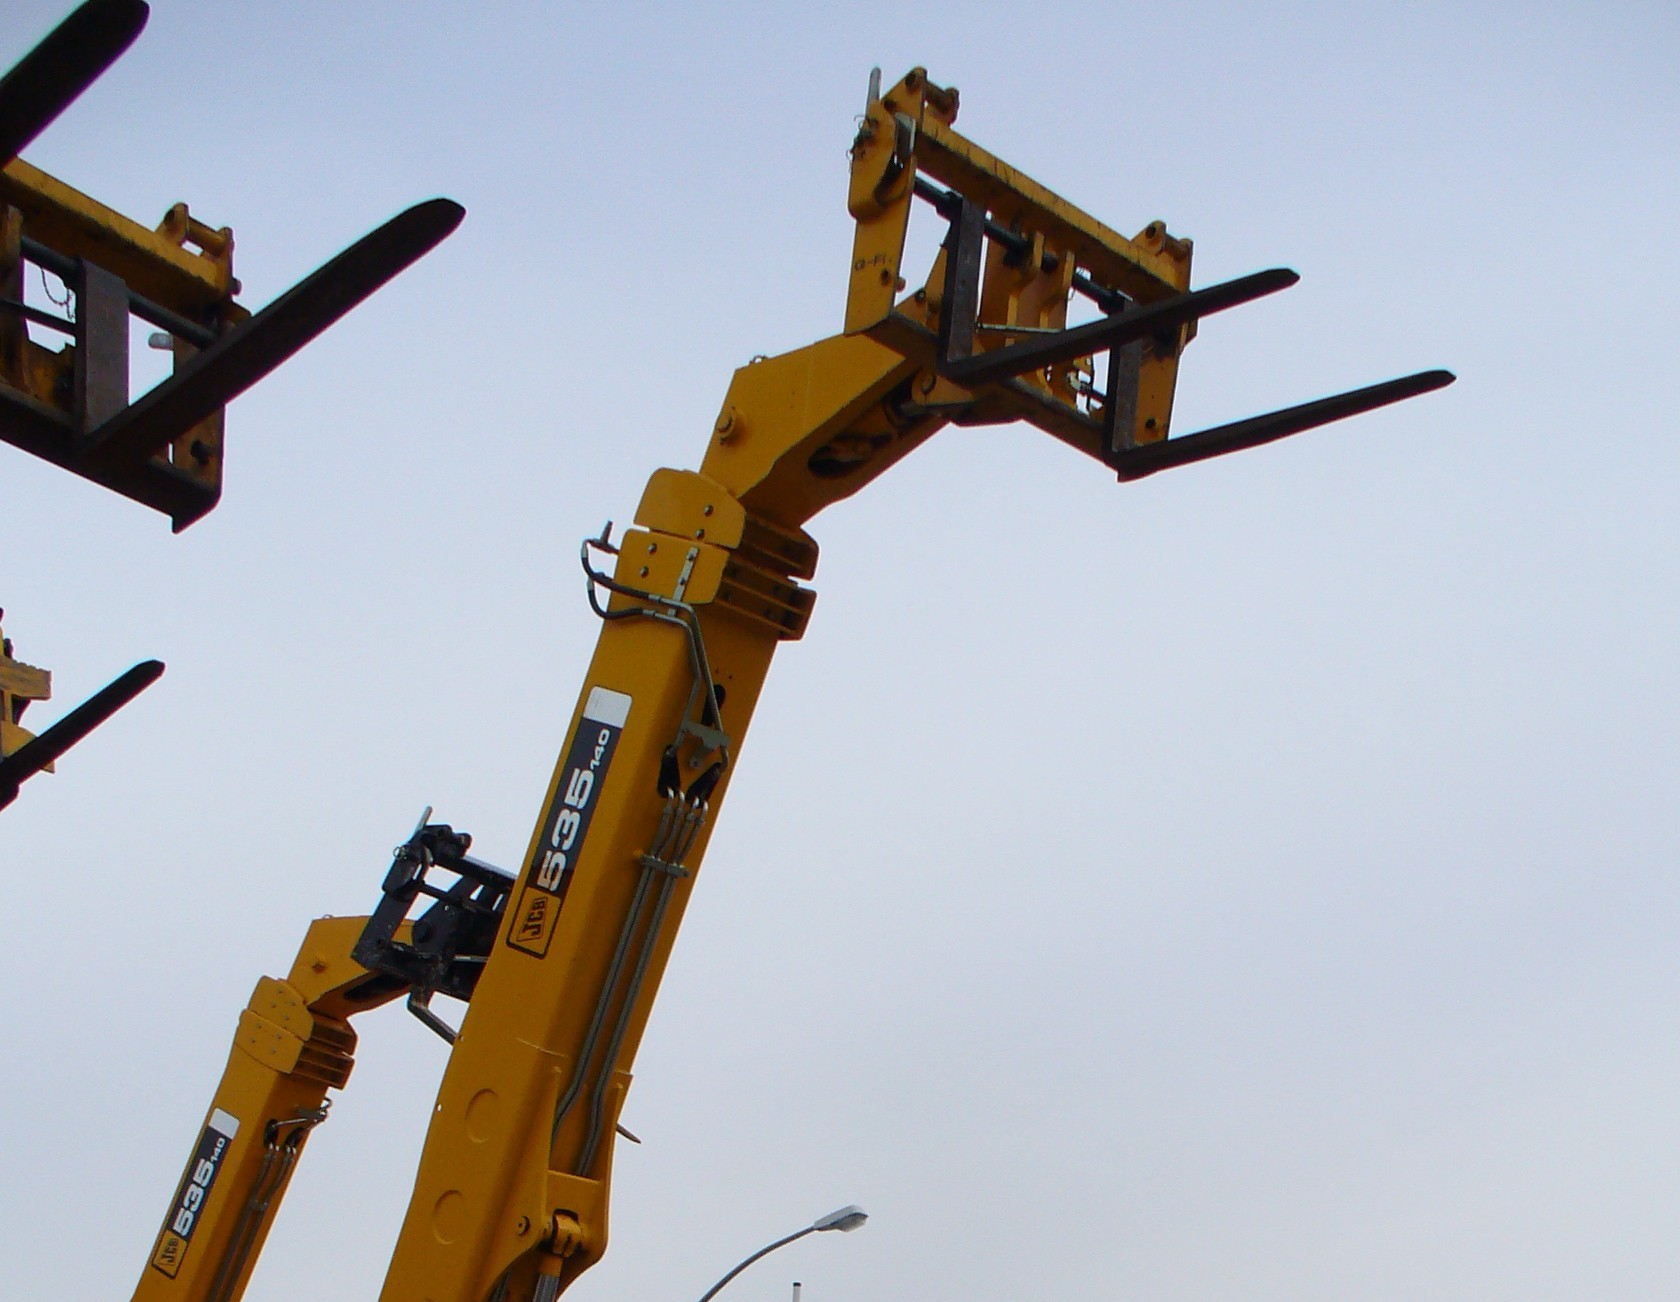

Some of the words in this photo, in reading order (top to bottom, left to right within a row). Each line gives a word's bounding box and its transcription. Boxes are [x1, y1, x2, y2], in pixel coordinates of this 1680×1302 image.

[521, 896, 548, 937] JCB
[537, 767, 595, 892] 535
[590, 729, 610, 770] 140
[162, 1237, 179, 1263] JCB
[172, 1158, 215, 1237] 535
[210, 1137, 226, 1163] 140
